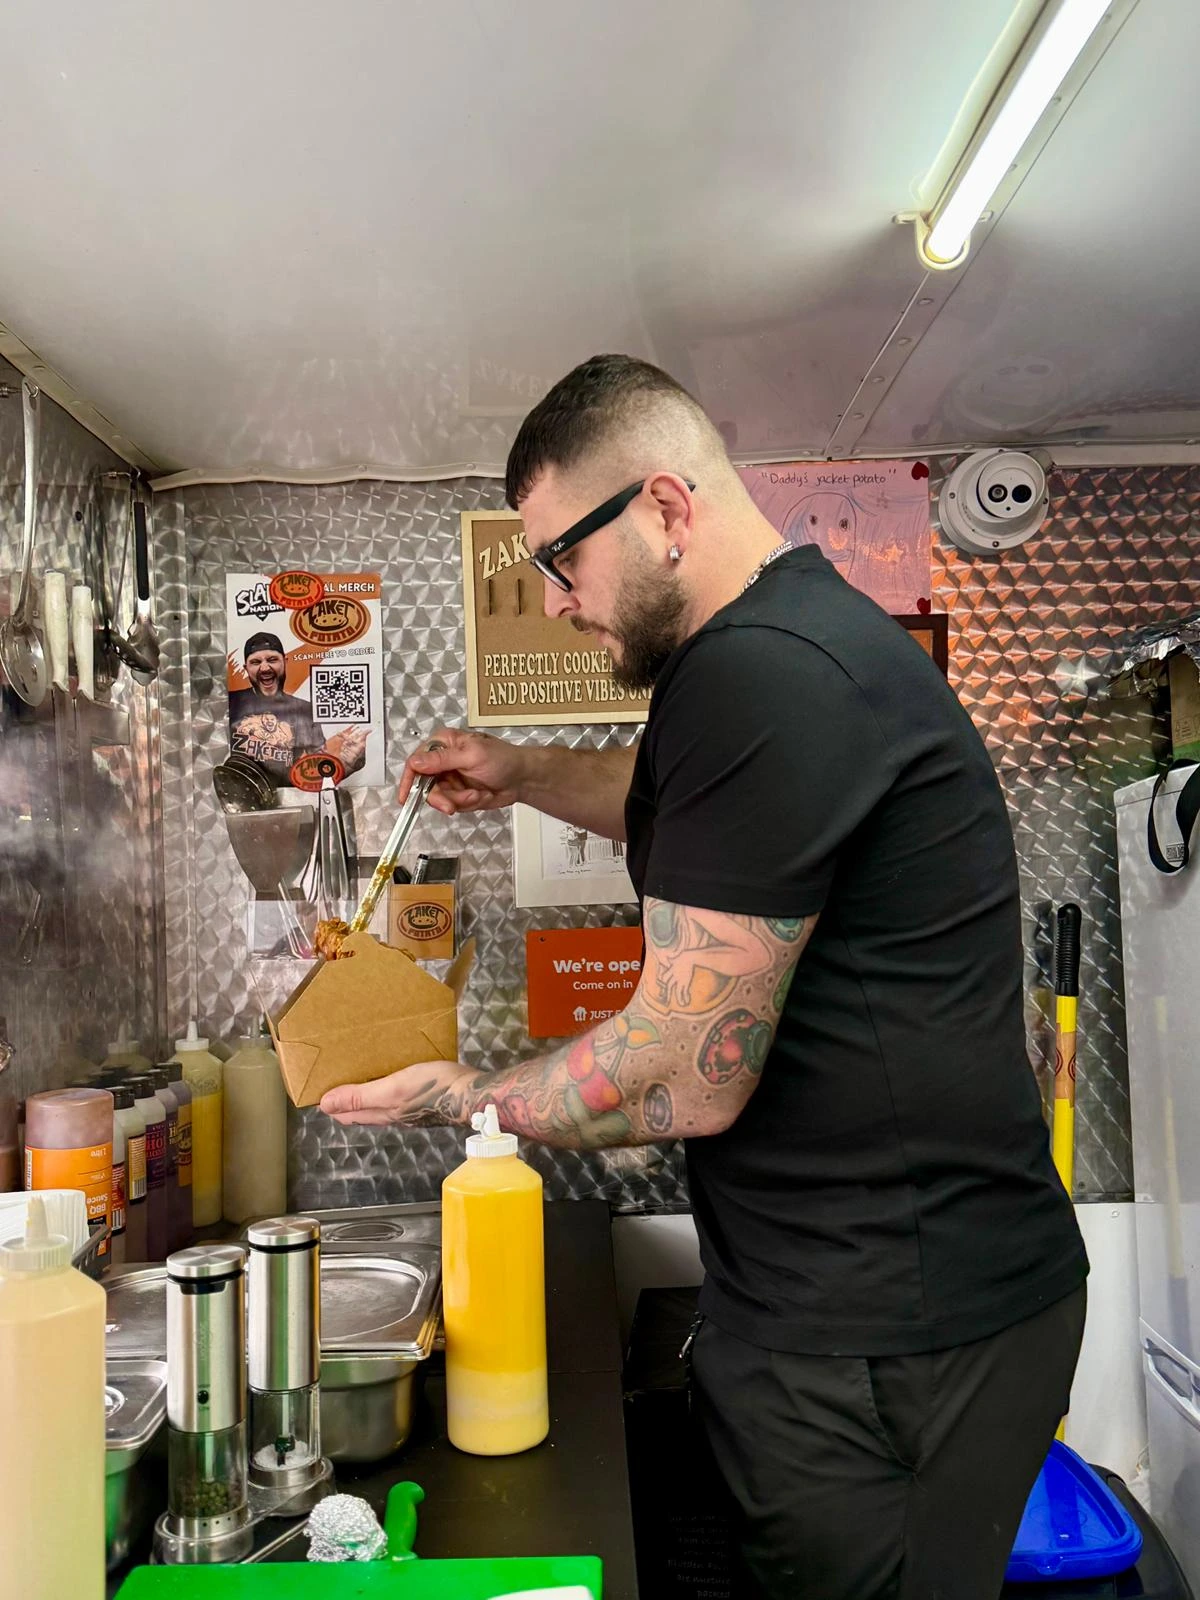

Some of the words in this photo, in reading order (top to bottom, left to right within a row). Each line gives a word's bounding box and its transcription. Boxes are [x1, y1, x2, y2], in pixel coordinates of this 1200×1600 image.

[816, 473, 849, 487] jacket
[479, 532, 534, 580] ZAK
[338, 583, 375, 592] MERCH
[249, 603, 283, 613] NATION
[293, 653, 313, 661] SCAN
[316, 652, 335, 660] HERE
[336, 650, 347, 658] TO
[348, 647, 375, 657] ORDER
[484, 651, 559, 677] PERFECTLY
[487, 681, 517, 705] AND
[520, 679, 582, 704] POSITIVE
[585, 678, 625, 702] VIBES
[553, 958, 604, 974] We're
[608, 960, 641, 975] ope
[573, 981, 604, 991] Come
[607, 981, 621, 990] on
[623, 979, 633, 989] in
[590, 1010, 614, 1019] JUST
